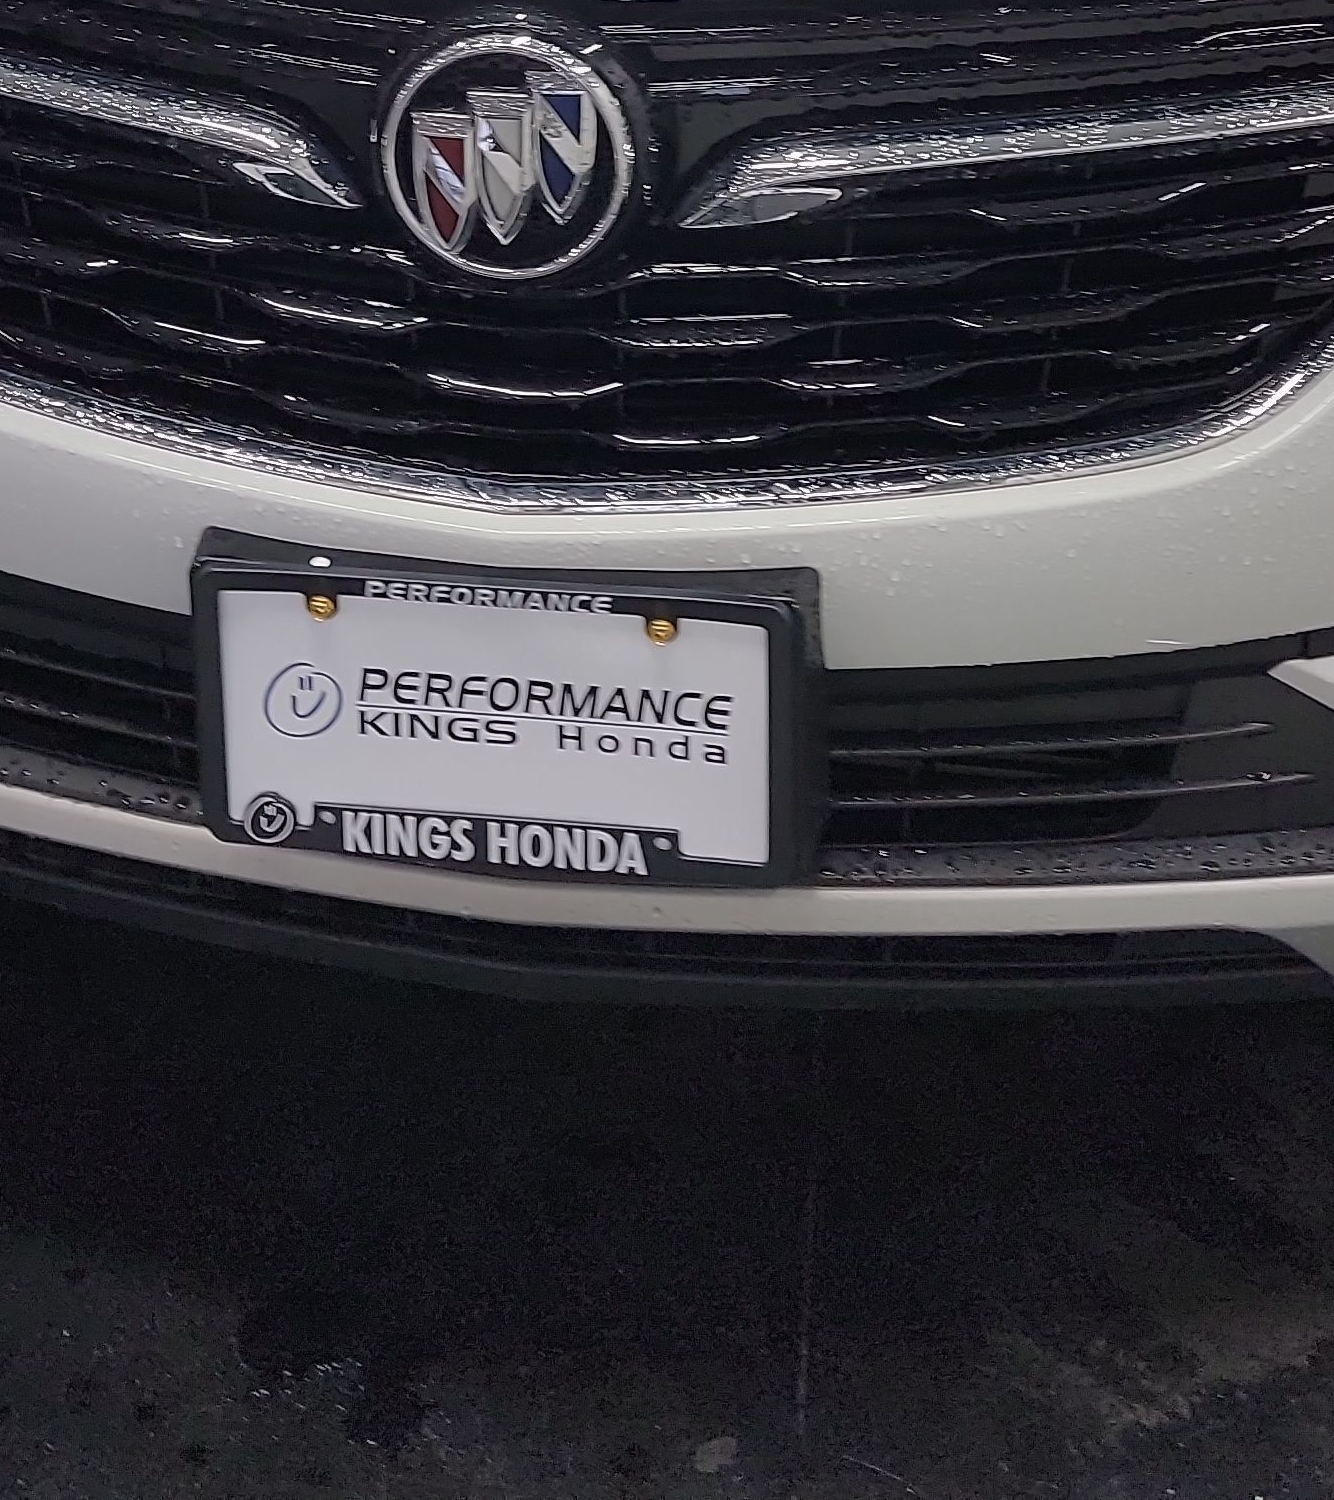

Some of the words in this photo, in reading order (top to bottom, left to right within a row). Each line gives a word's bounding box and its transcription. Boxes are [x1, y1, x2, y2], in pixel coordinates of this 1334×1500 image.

[363, 579, 613, 614] PERFORMANCE
[360, 667, 735, 730] PERFORMANCE
[358, 711, 517, 745] KINGS
[558, 725, 729, 765] Honda
[341, 810, 476, 862] KINGS
[485, 821, 649, 876] HONDA
